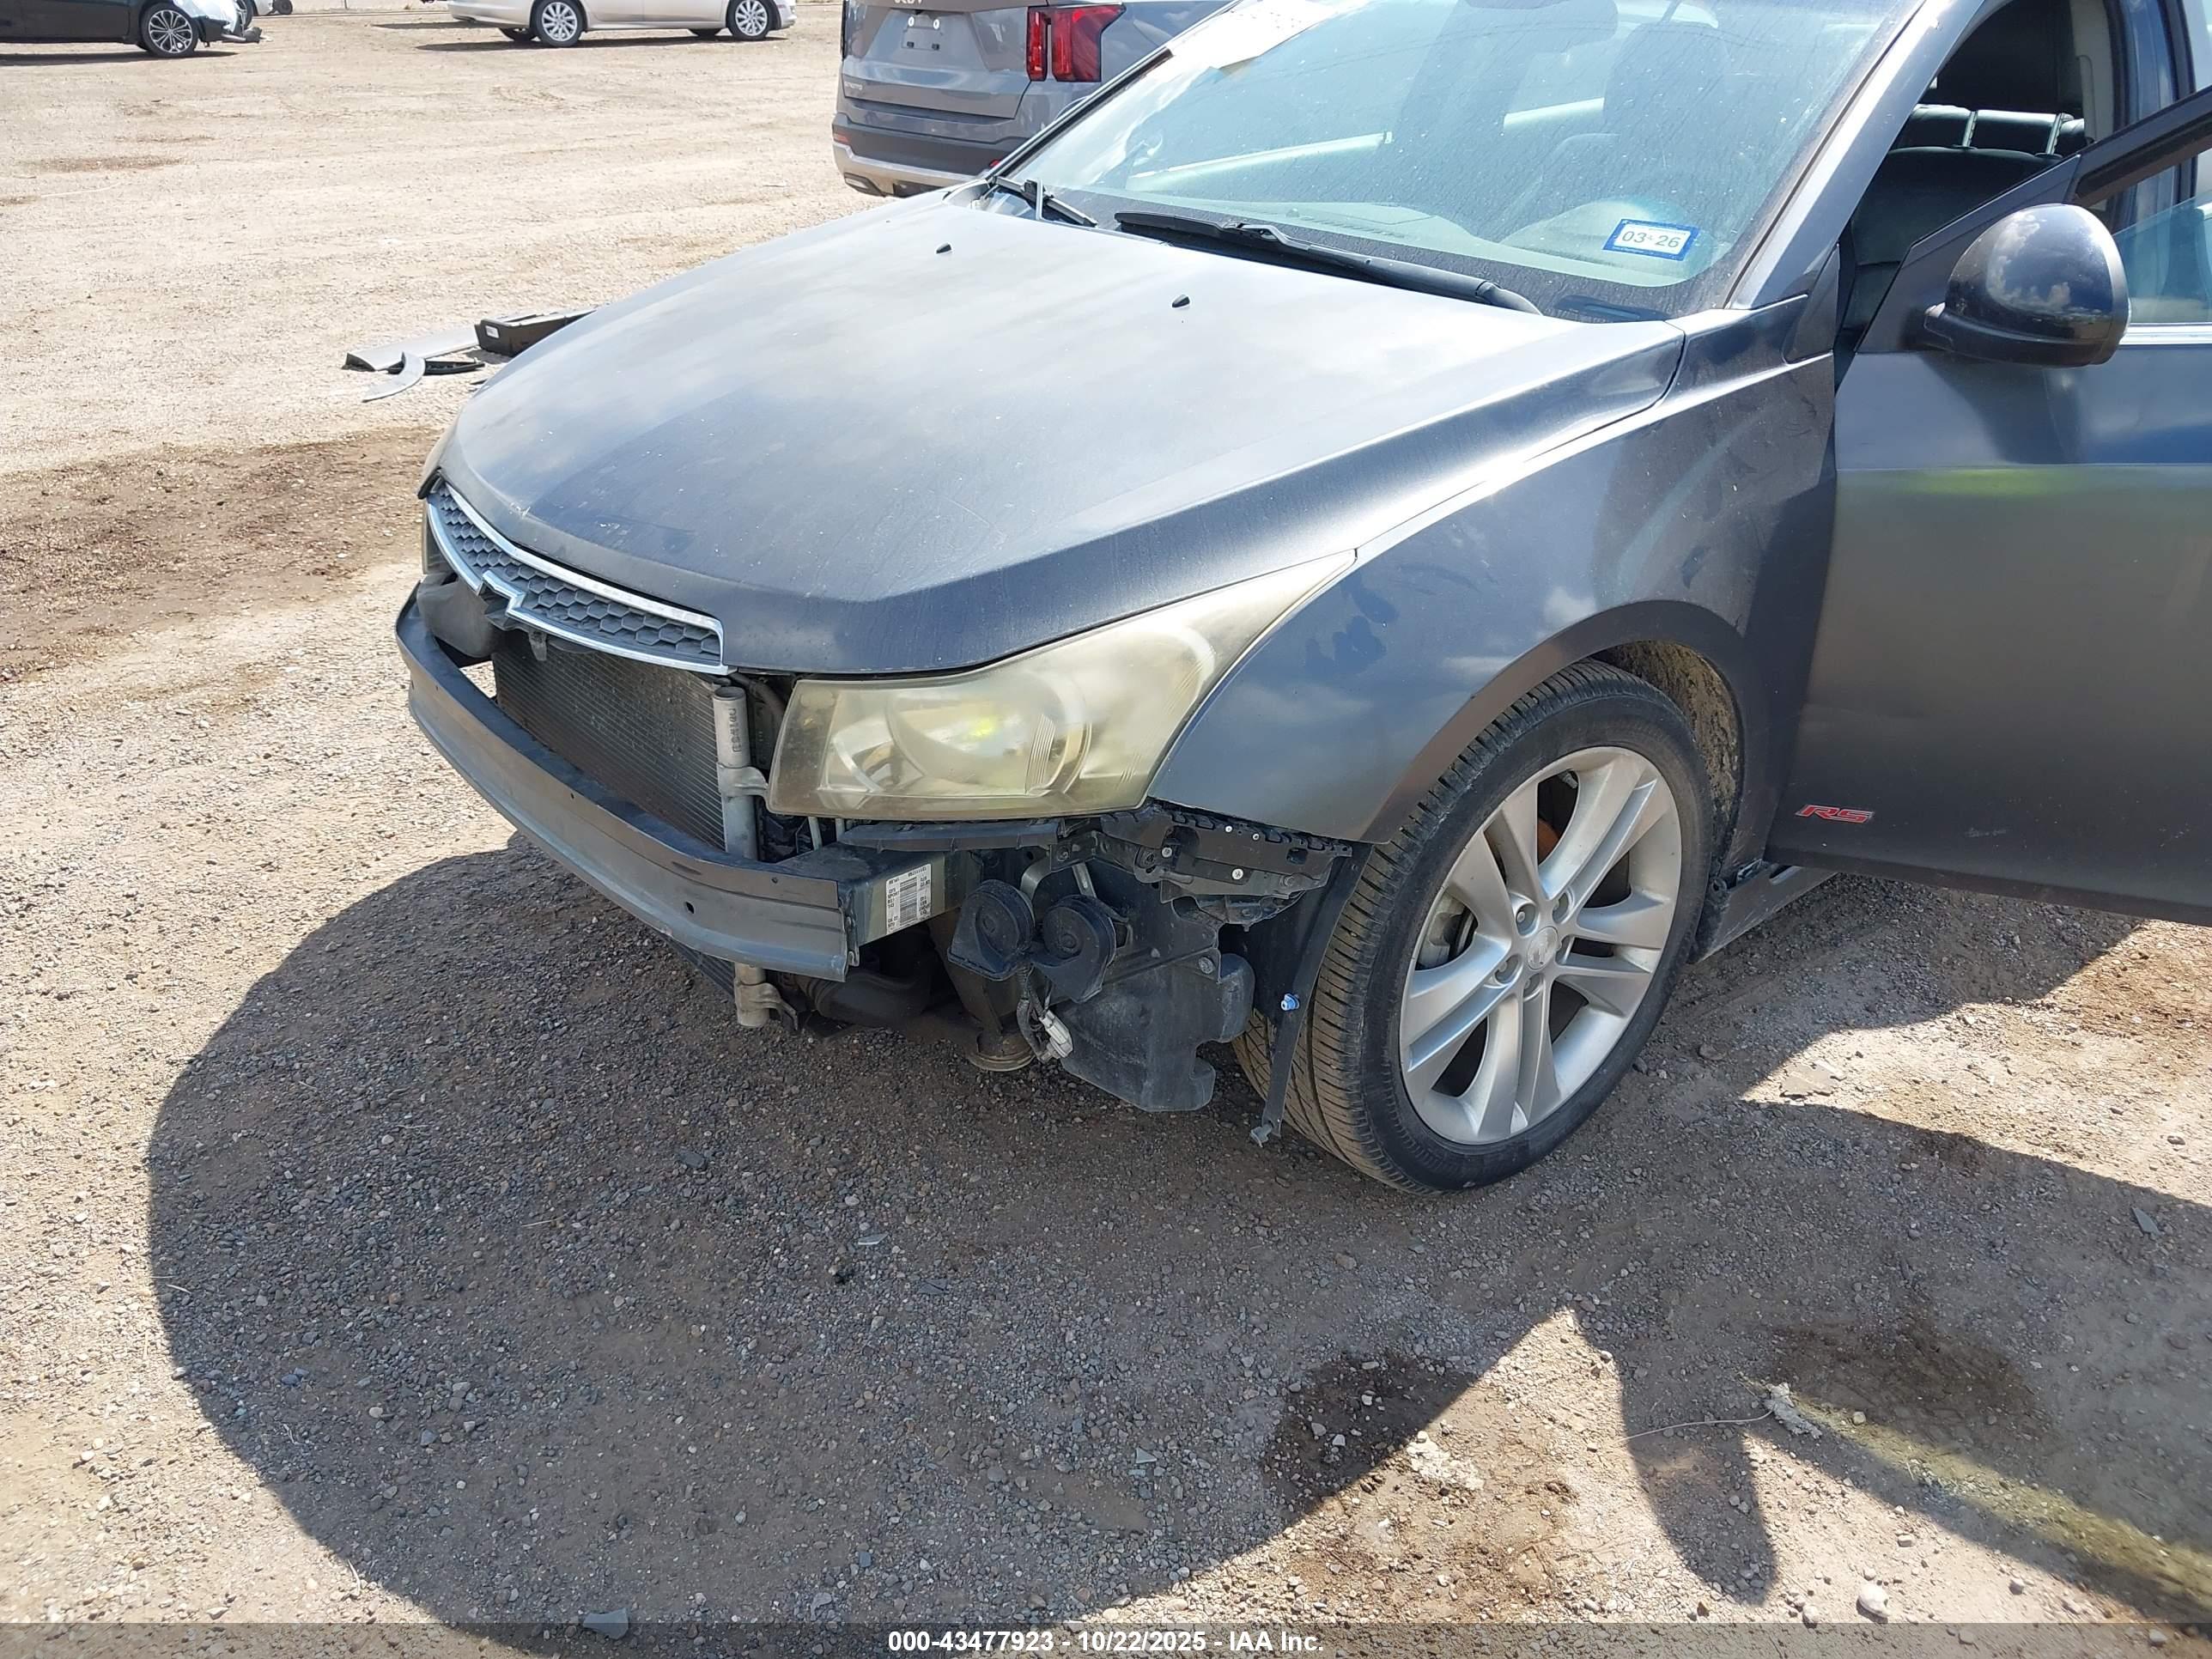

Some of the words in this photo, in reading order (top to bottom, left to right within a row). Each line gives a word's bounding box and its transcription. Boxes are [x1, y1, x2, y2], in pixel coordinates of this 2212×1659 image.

[1622, 231, 1647, 243] 03
[1656, 235, 1680, 247] 26
[1795, 805, 1874, 823] RS
